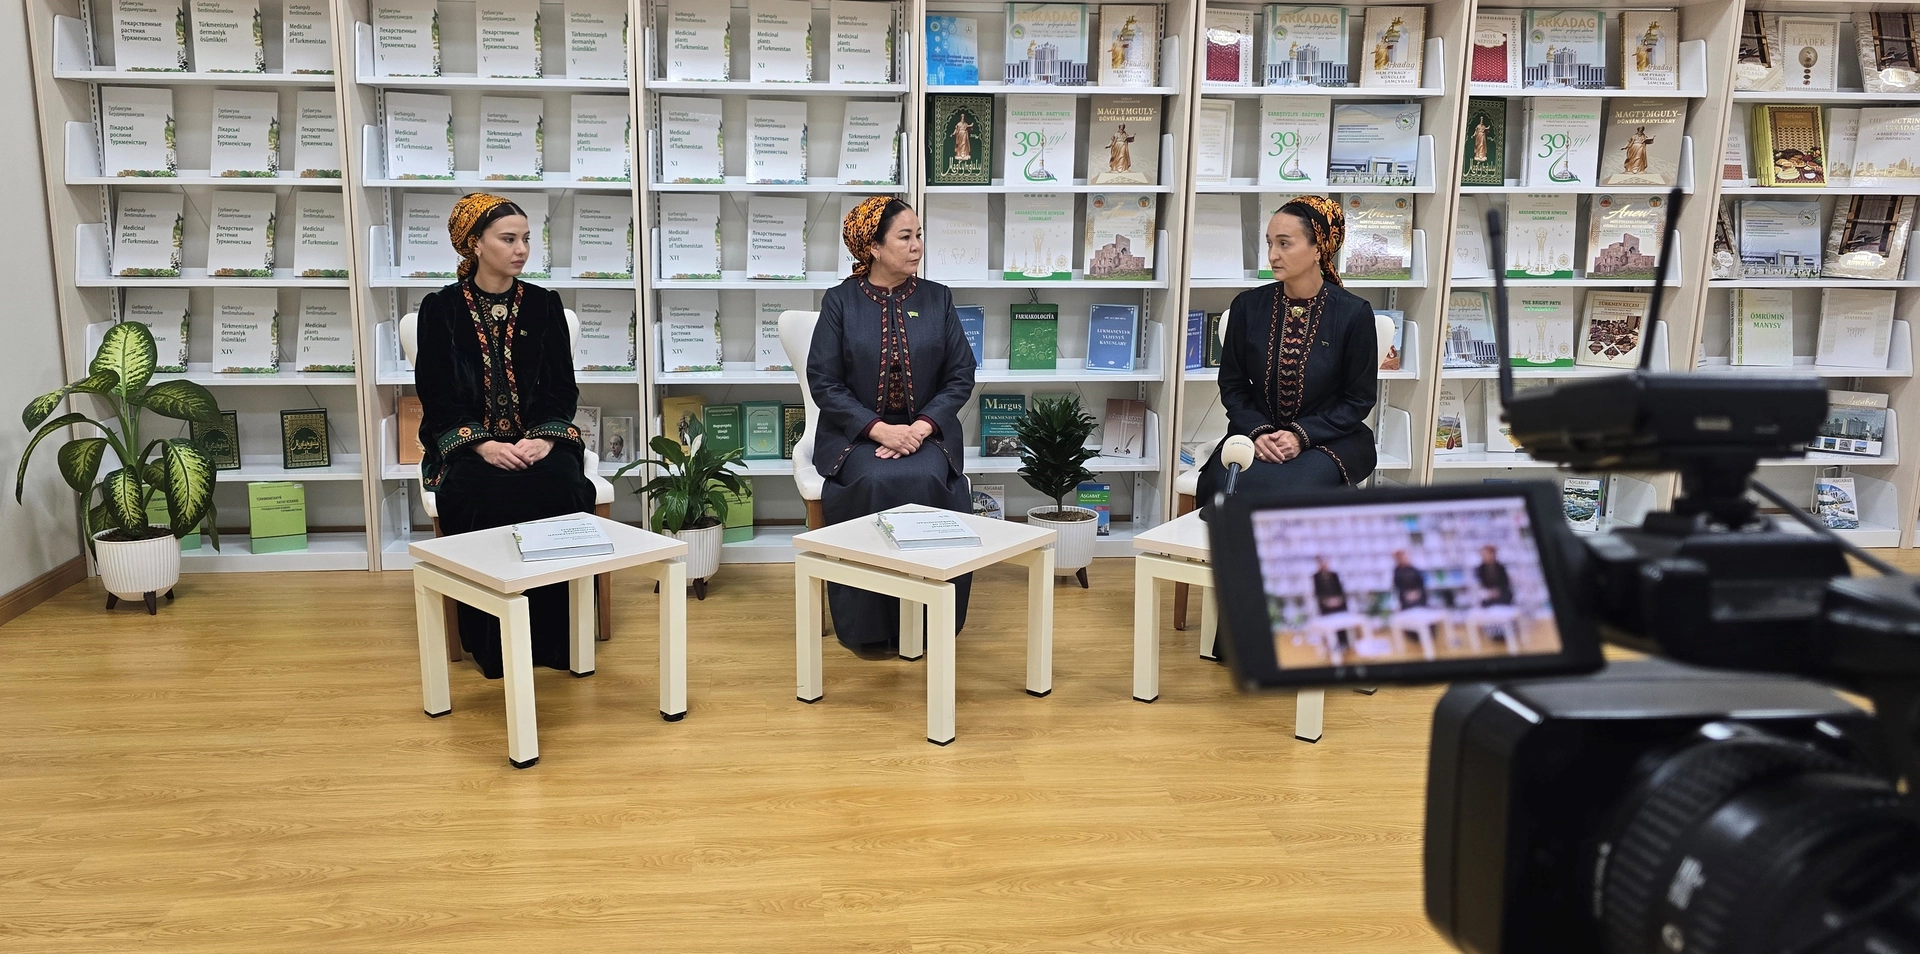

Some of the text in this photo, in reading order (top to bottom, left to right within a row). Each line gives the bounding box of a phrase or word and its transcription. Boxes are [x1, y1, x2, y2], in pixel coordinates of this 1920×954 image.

[120, 20, 161, 28] Лекарственные
[1279, 13, 1339, 24] ARKADAG
[1536, 17, 1596, 28] ARKADAG
[1793, 38, 1825, 47] LEADER
[1012, 131, 1041, 157] 30
[1268, 132, 1297, 157] 30
[1537, 133, 1565, 159] 30
[1750, 312, 1784, 320] ÖMRÜMIŇ
[1753, 321, 1782, 329] MANYSY
[985, 398, 1022, 411] Marguş
